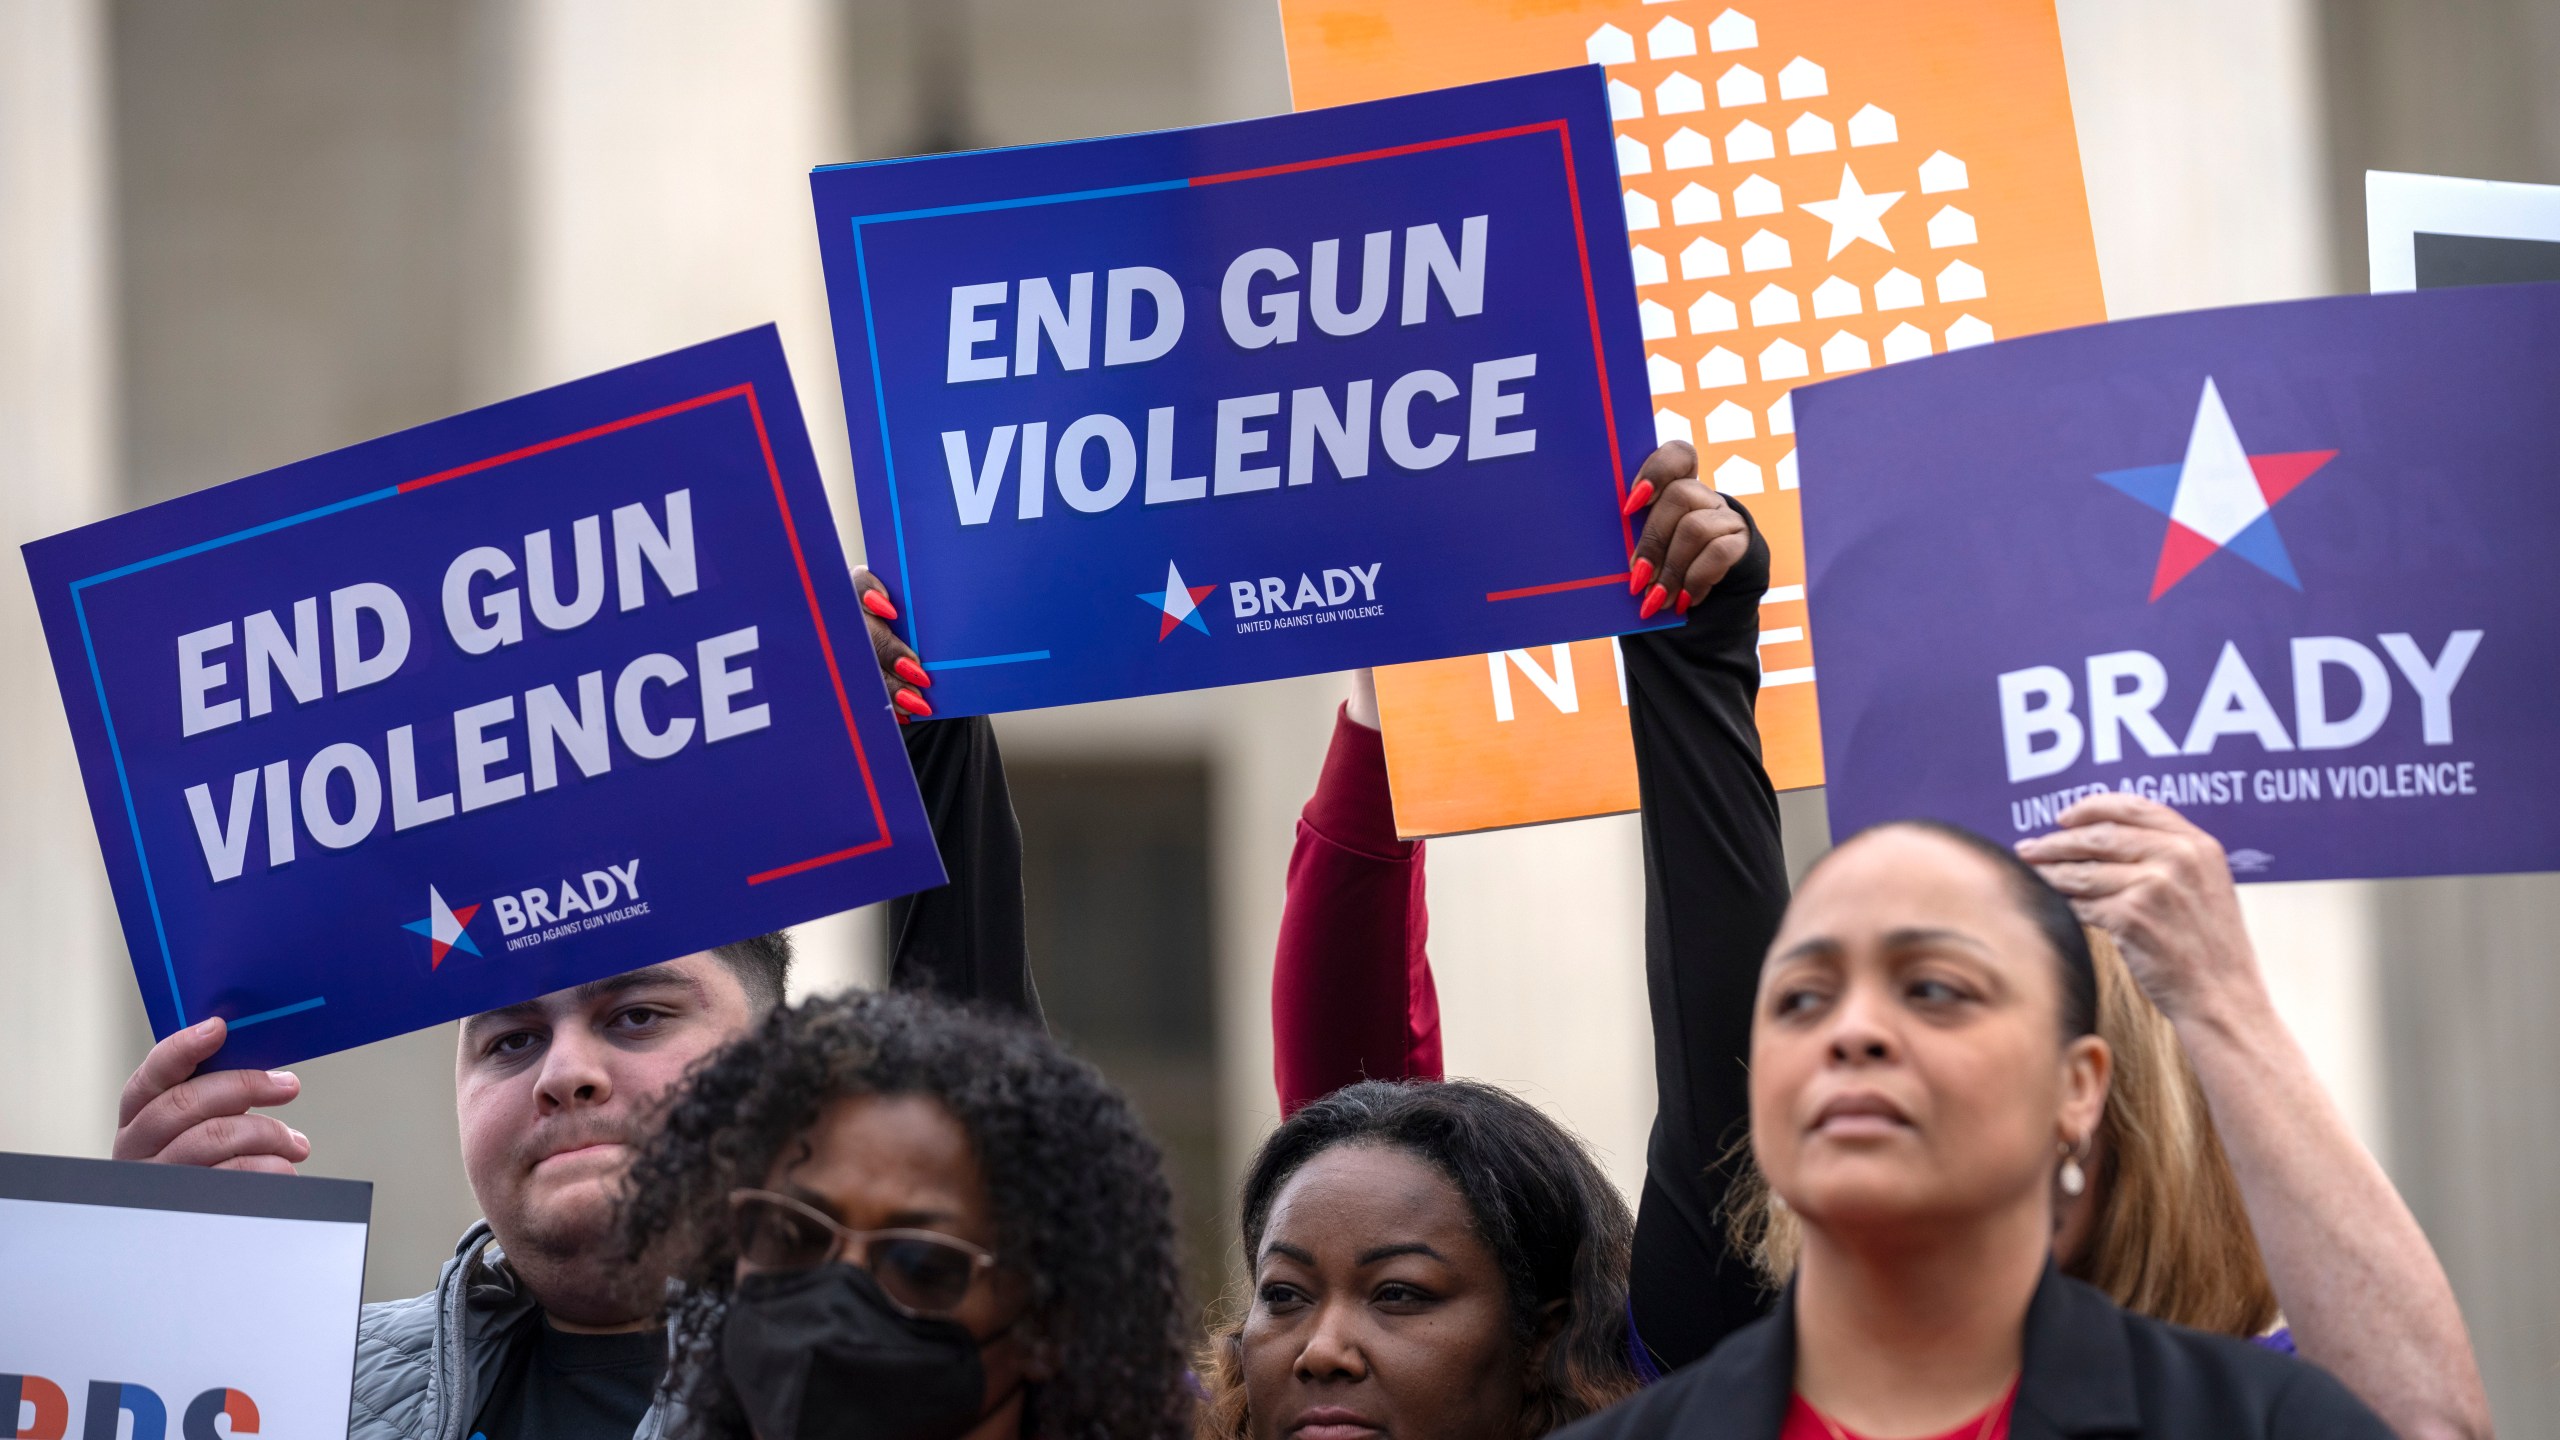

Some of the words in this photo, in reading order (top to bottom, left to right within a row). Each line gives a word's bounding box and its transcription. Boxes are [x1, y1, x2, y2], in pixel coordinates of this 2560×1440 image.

[946, 266, 1185, 384] END
[1220, 214, 1489, 349] GUN
[941, 353, 1537, 526] VIOLENCE
[178, 583, 411, 738] END
[441, 488, 699, 655] GUN
[1230, 562, 1382, 619] BRADY
[1236, 620, 1272, 634] UNITED
[1274, 614, 1314, 630] AGAINST
[1316, 611, 1337, 624] GUN
[1338, 604, 1385, 621] VIOLENCE
[184, 626, 771, 883] VIOLENCE
[1998, 630, 2483, 783] BRADY
[2253, 769, 2321, 802] GUN
[2326, 762, 2477, 800] VIOLENCE
[493, 858, 640, 936] BRADY
[506, 933, 541, 951] UNITED
[542, 921, 582, 943] AGAINST
[583, 916, 604, 930] GUN
[604, 901, 651, 926] VIOLENCE
